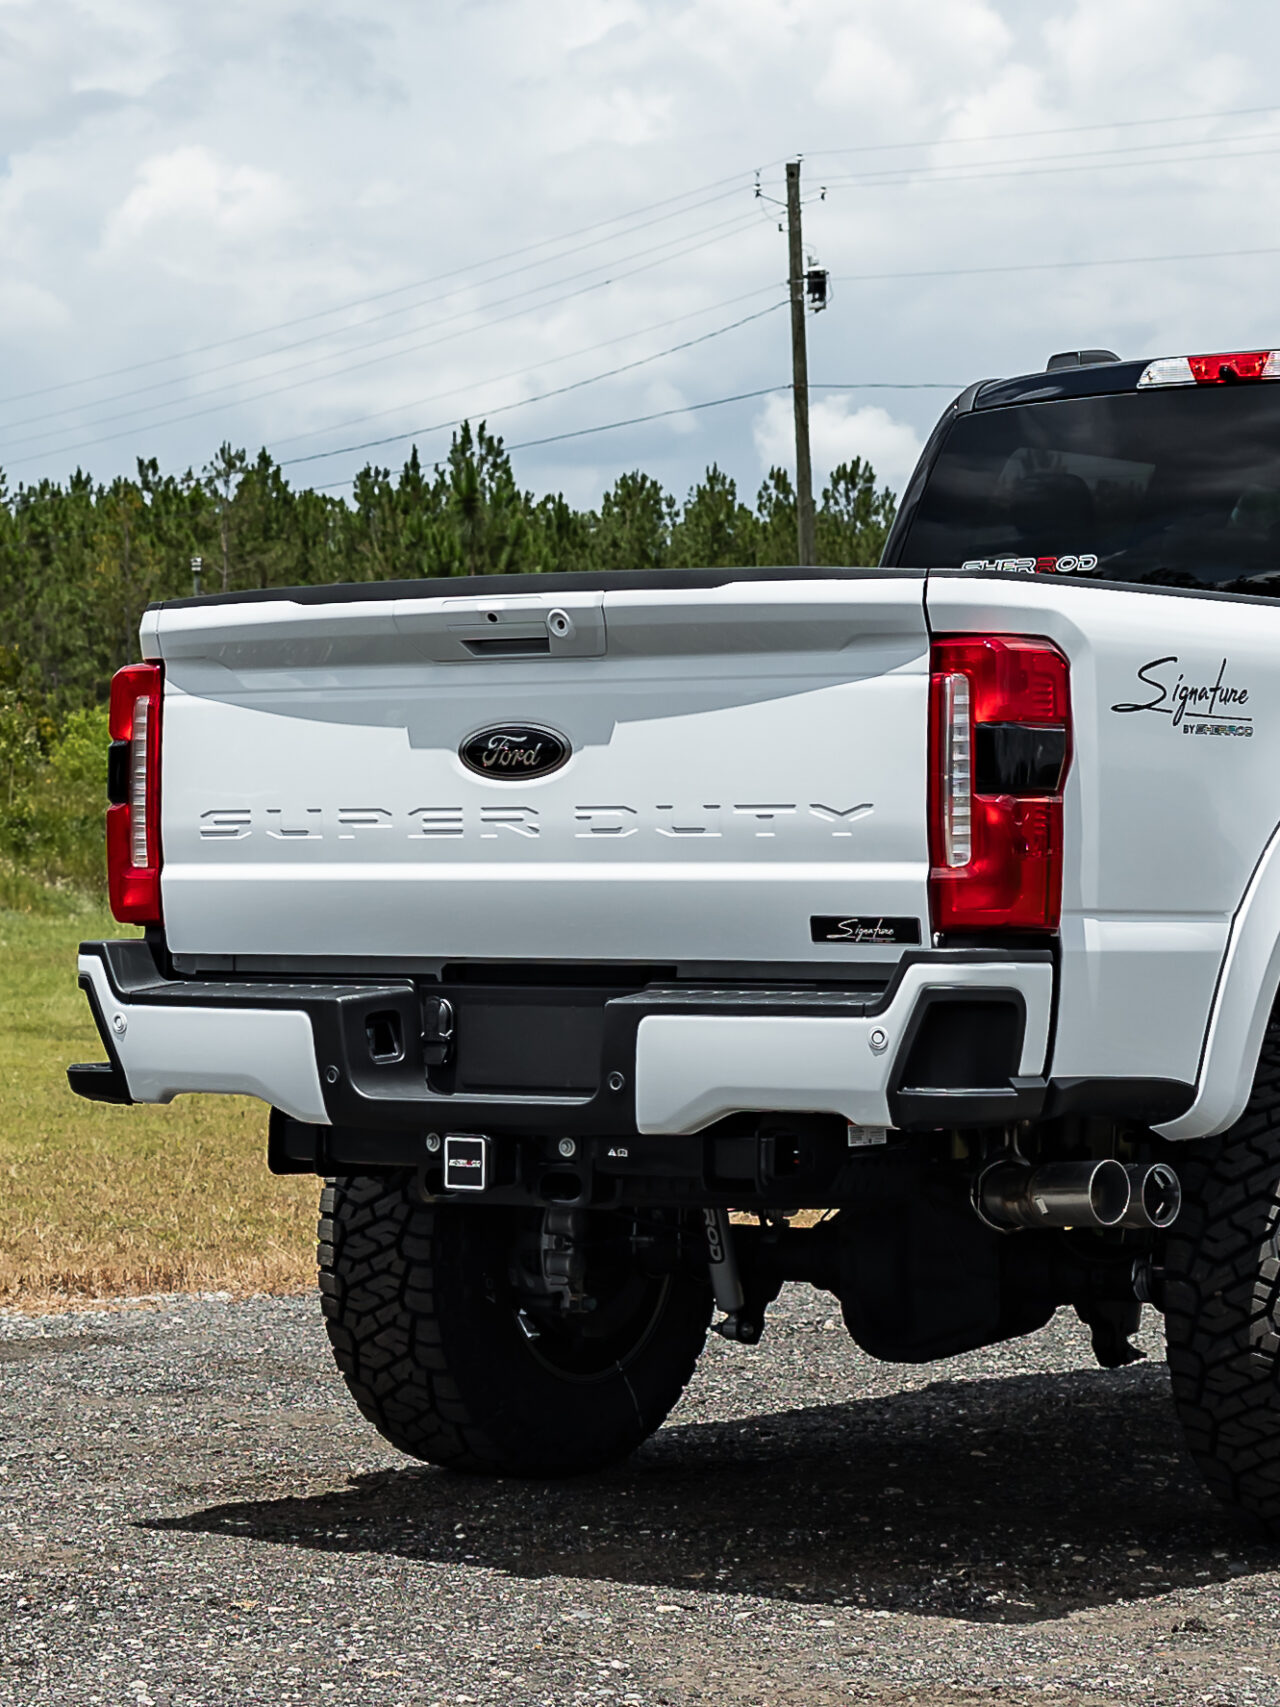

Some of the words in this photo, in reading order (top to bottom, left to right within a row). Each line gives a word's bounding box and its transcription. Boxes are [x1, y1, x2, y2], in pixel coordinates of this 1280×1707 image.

[962, 554, 1098, 574] SHERROD
[1111, 656, 1251, 726] Signature
[1183, 724, 1195, 735] BY
[482, 735, 543, 767] Ford
[200, 805, 540, 840] SUPER
[574, 803, 875, 838] DUTY
